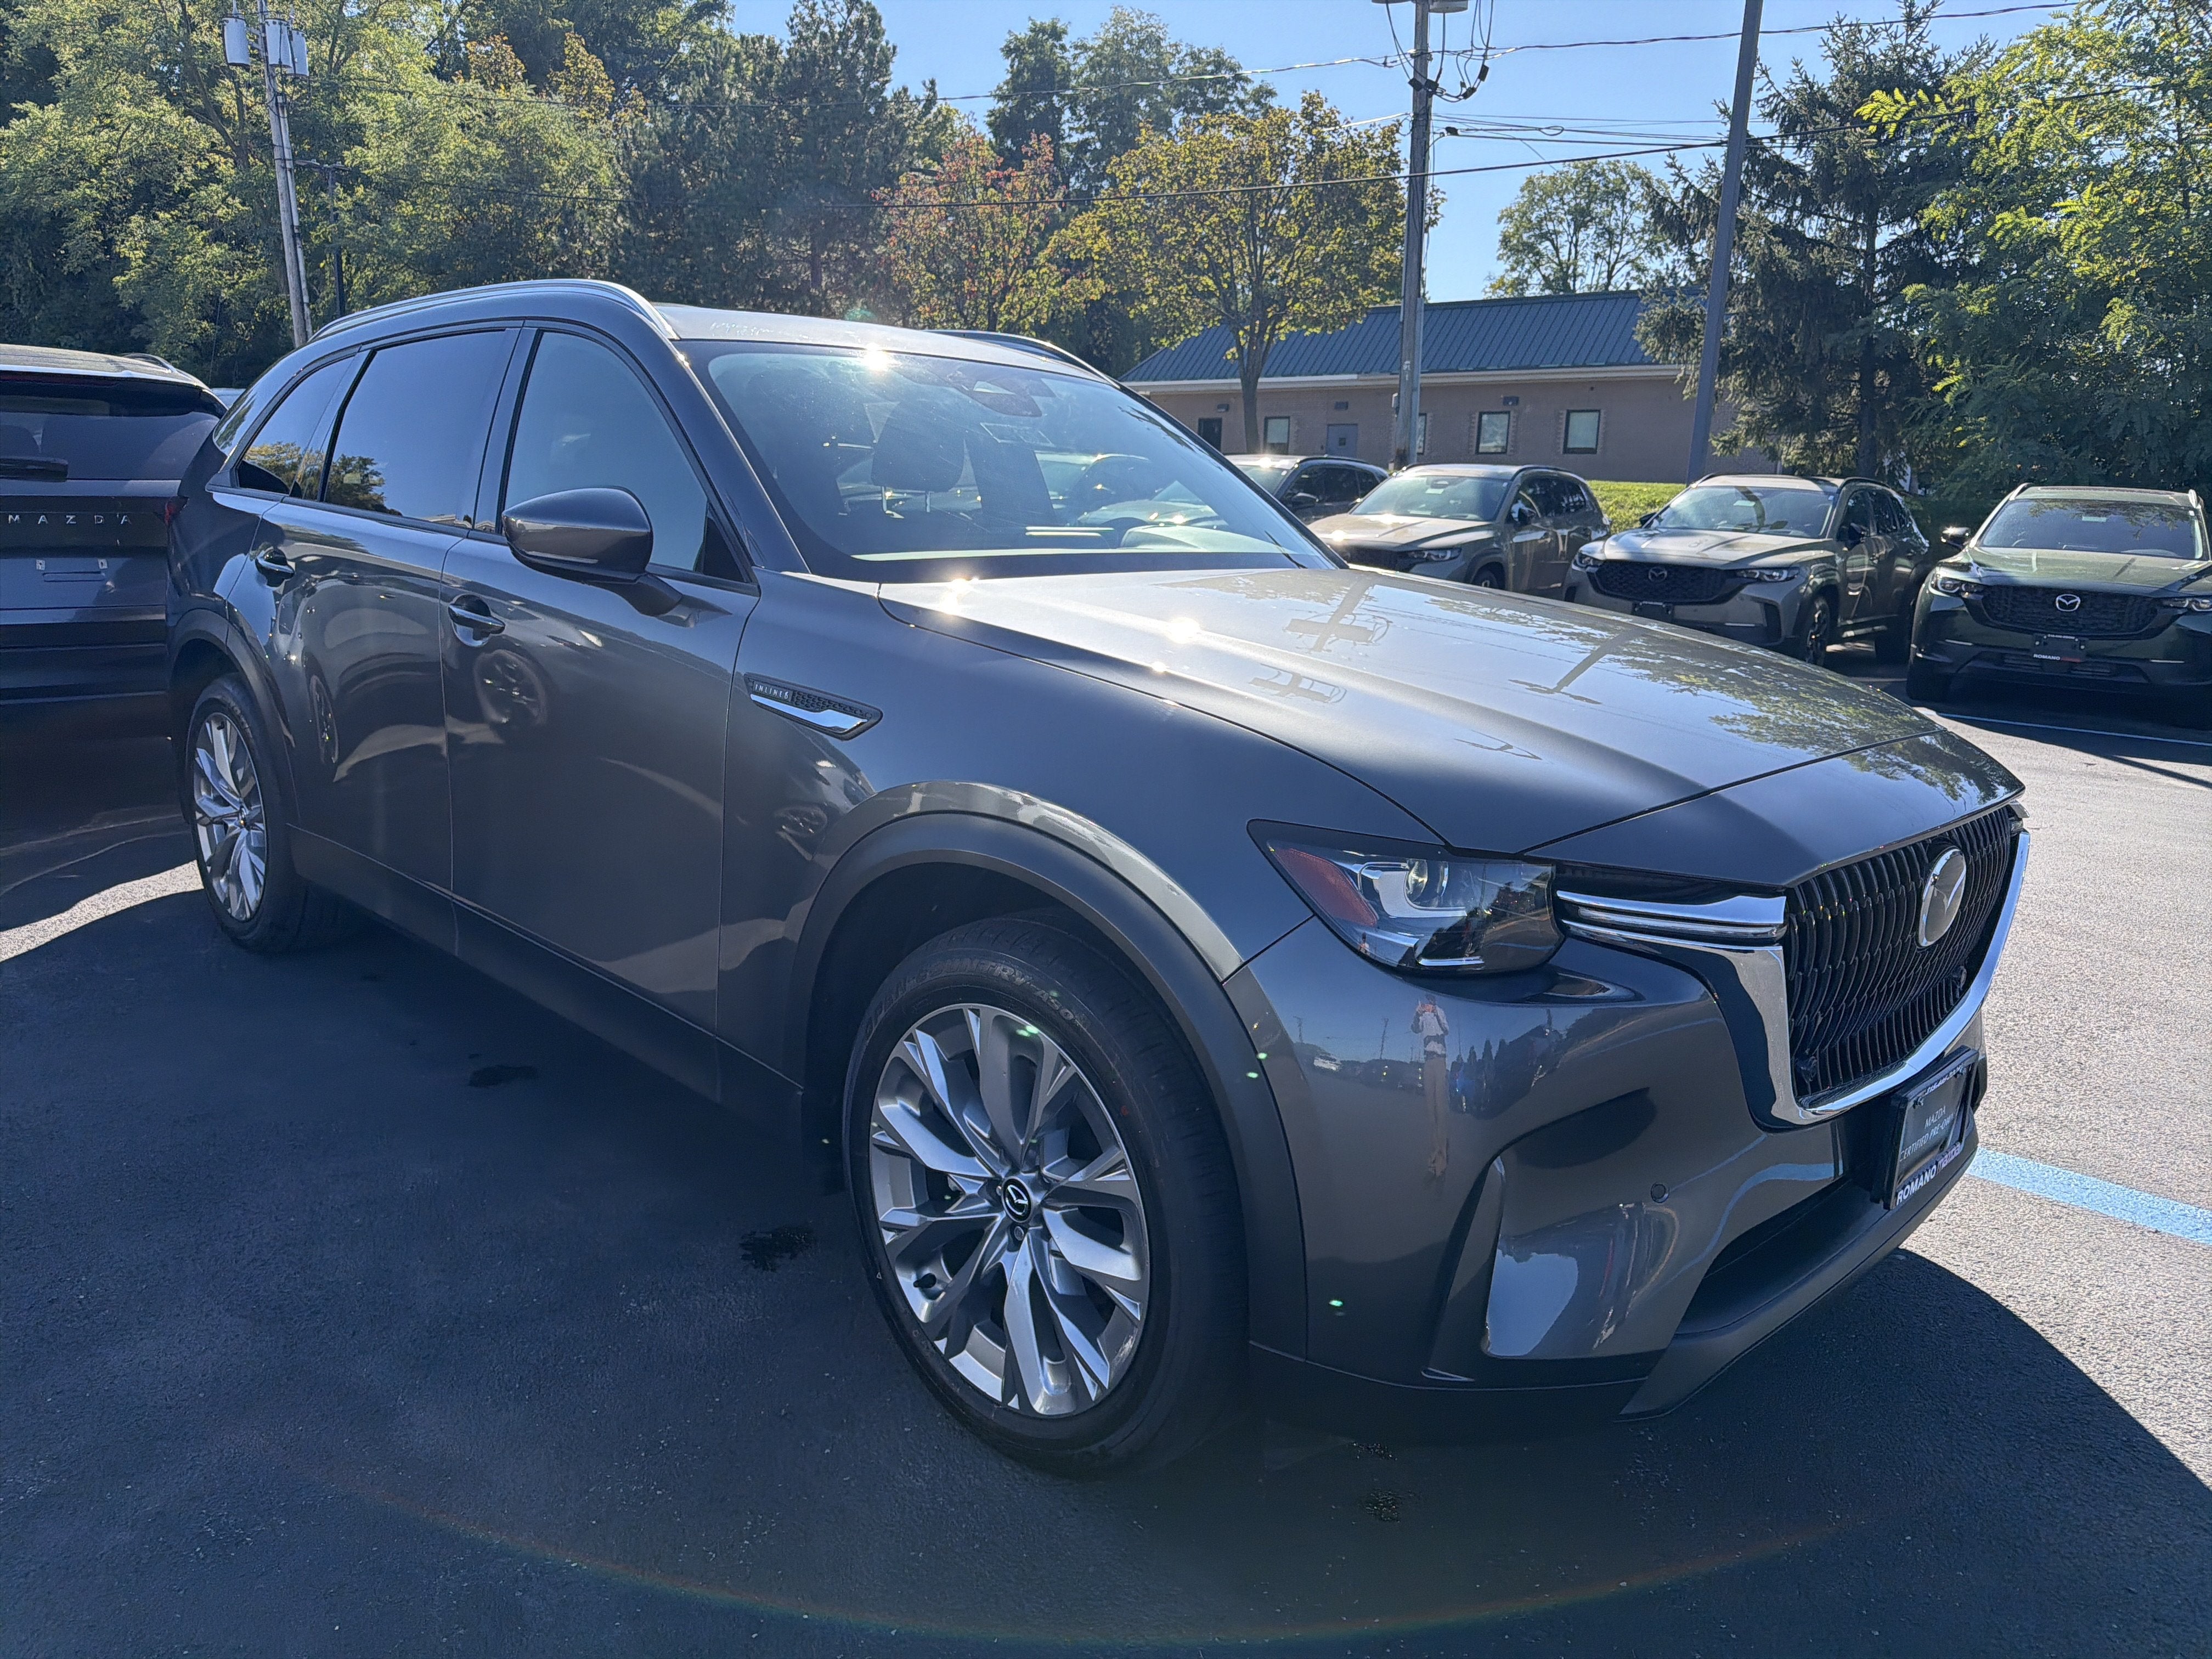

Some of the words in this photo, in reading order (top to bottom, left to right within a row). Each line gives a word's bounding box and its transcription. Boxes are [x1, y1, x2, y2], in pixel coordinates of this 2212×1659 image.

[8, 514, 133, 525] MAZDA
[1925, 1105, 1946, 1129] MAZDA
[1899, 1133, 1929, 1162] CERTIFIED
[1896, 1164, 1937, 1206] ROMANO
